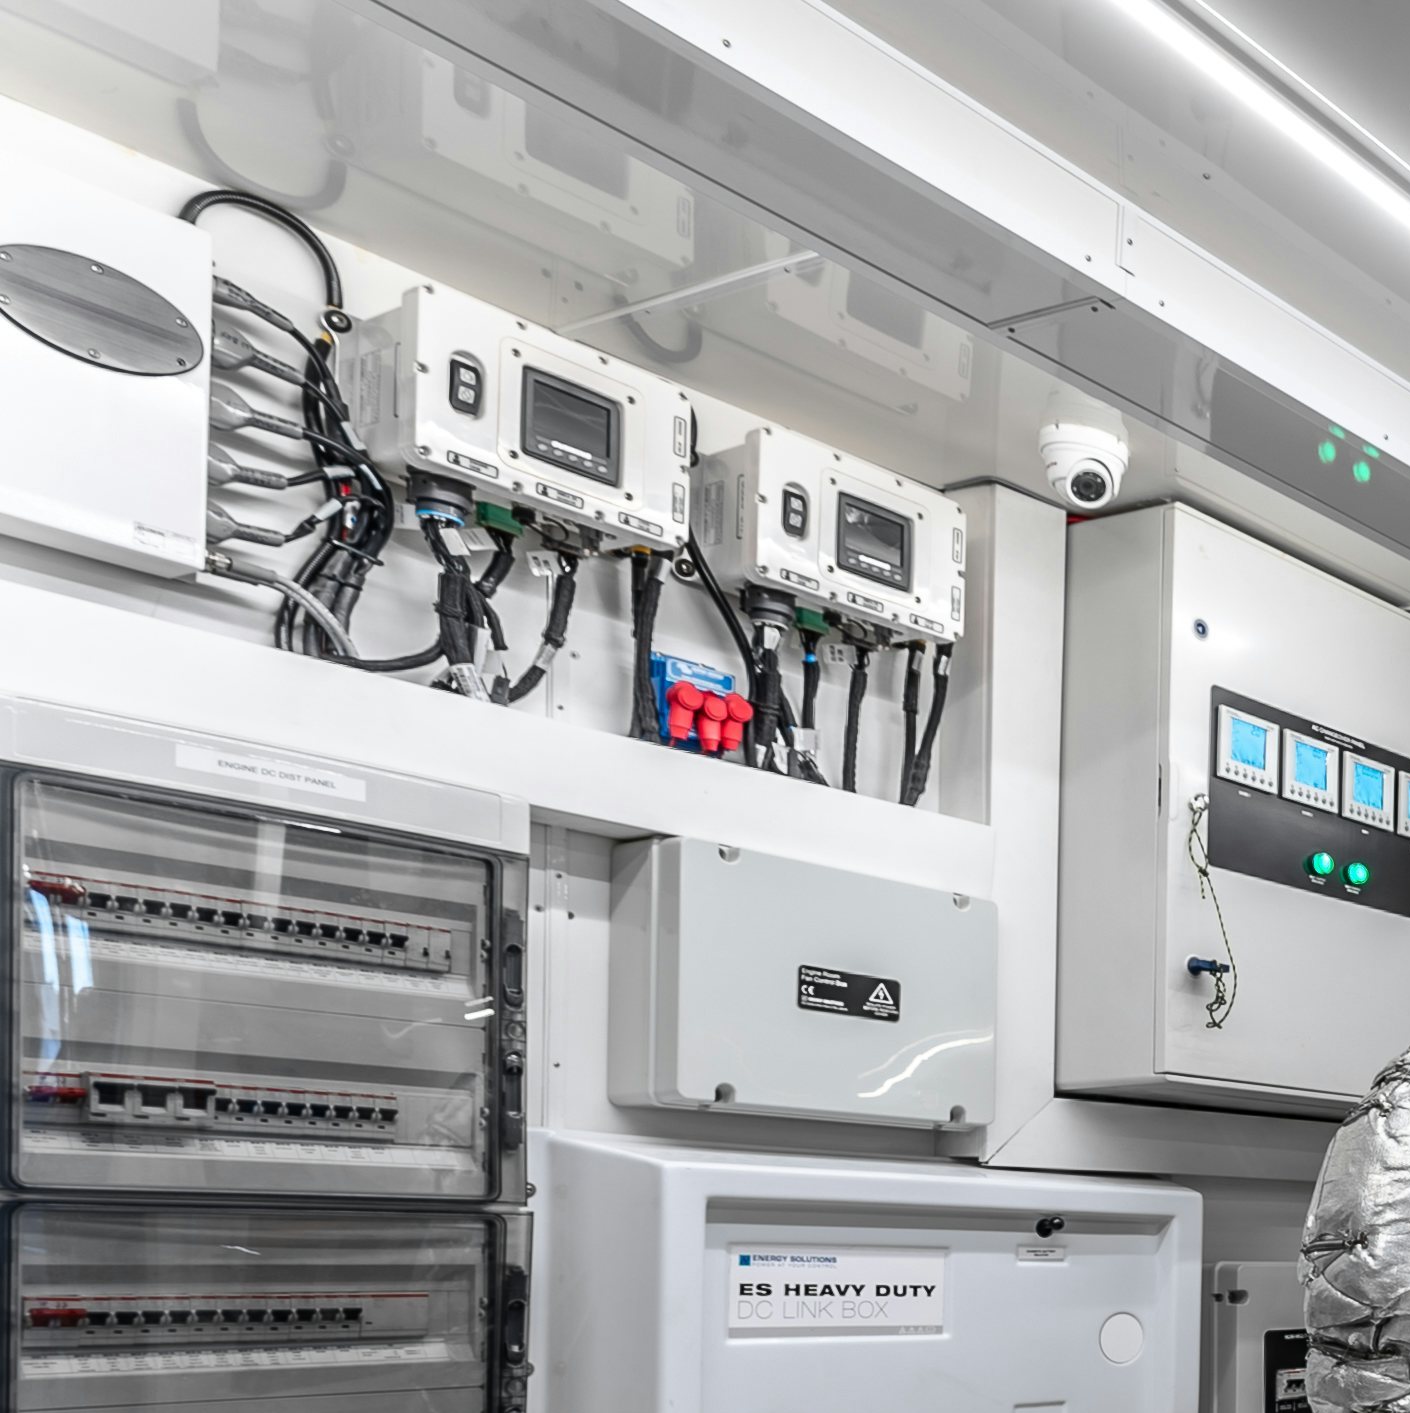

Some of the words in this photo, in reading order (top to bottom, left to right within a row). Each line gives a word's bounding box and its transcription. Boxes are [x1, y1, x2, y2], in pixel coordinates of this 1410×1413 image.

[217, 759, 258, 775] ENGINE
[261, 767, 277, 778] DC
[279, 771, 301, 782] DIST
[304, 776, 337, 790] PANEL
[753, 1255, 788, 1264] ENERGY
[789, 1254, 837, 1264] SOLUTIONS
[739, 1283, 773, 1297] ES
[784, 1283, 866, 1297] HEAVY
[875, 1284, 937, 1297] DUTY
[737, 1300, 774, 1320] DC
[782, 1301, 834, 1320] LINK
[841, 1301, 889, 1320] BOX
